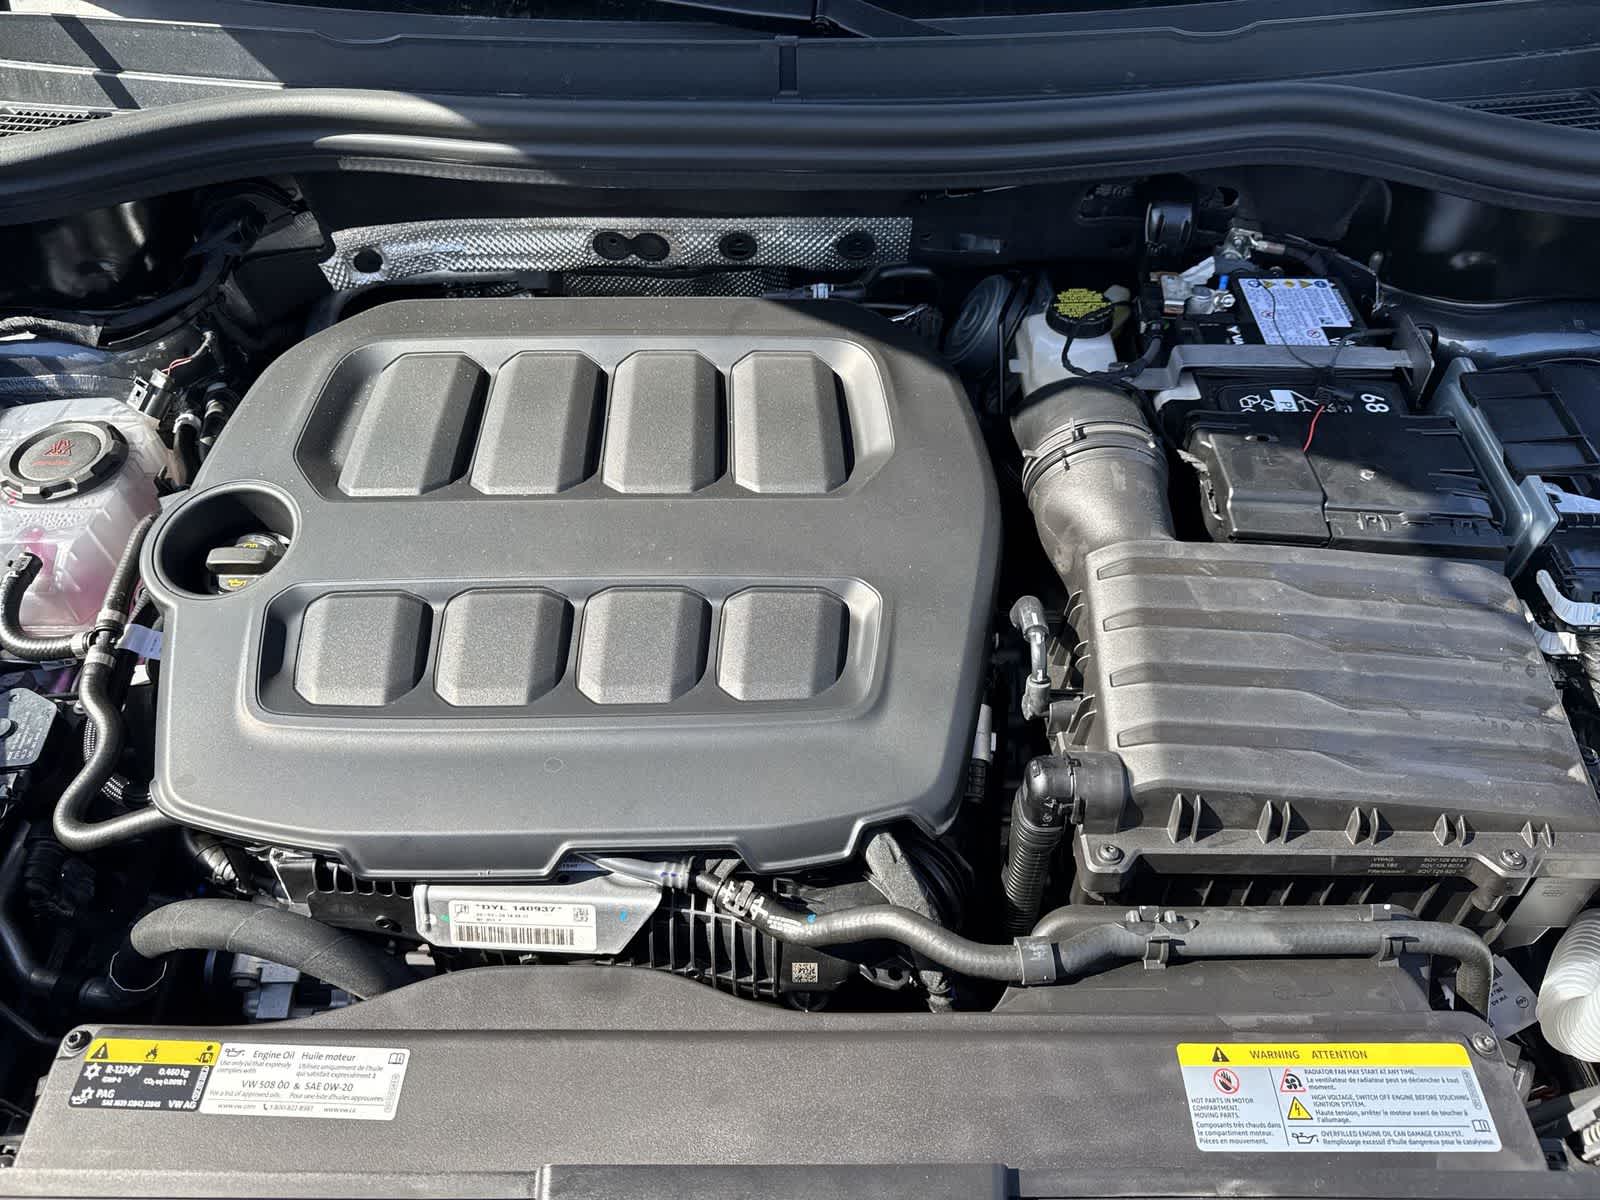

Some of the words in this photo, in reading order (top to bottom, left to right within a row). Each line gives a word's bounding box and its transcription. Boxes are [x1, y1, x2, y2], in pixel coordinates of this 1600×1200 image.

[1360, 393, 1390, 413] 68
[253, 1050, 281, 1060] Engine
[283, 1051, 295, 1060] Oil
[302, 1051, 324, 1061] Huile
[325, 1054, 356, 1062] moteur
[1249, 1049, 1300, 1060] WARNING
[1312, 1050, 1368, 1060] ATTENTION
[105, 1065, 143, 1077] R-1234yf
[182, 1068, 191, 1078] kg
[242, 1080, 257, 1088] VW
[259, 1080, 276, 1089] 508
[293, 1082, 300, 1090] &
[304, 1081, 322, 1091] SAE
[323, 1082, 354, 1091] 0W-20
[96, 1089, 115, 1099] PAG
[168, 1100, 183, 1108] VW
[183, 1100, 197, 1109] AG
[1192, 1104, 1240, 1112] COMPARTMENT.
[1194, 1111, 1219, 1119] MOVING
[1196, 1121, 1232, 1130] Composants
[1233, 1121, 1244, 1129] très
[1245, 1121, 1265, 1129] chauds
[1205, 1130, 1248, 1138] compartiment
[1199, 1137, 1219, 1145] Pièces
[1323, 1139, 1361, 1147] Remplissage
[1408, 1139, 1440, 1147] dangereux
